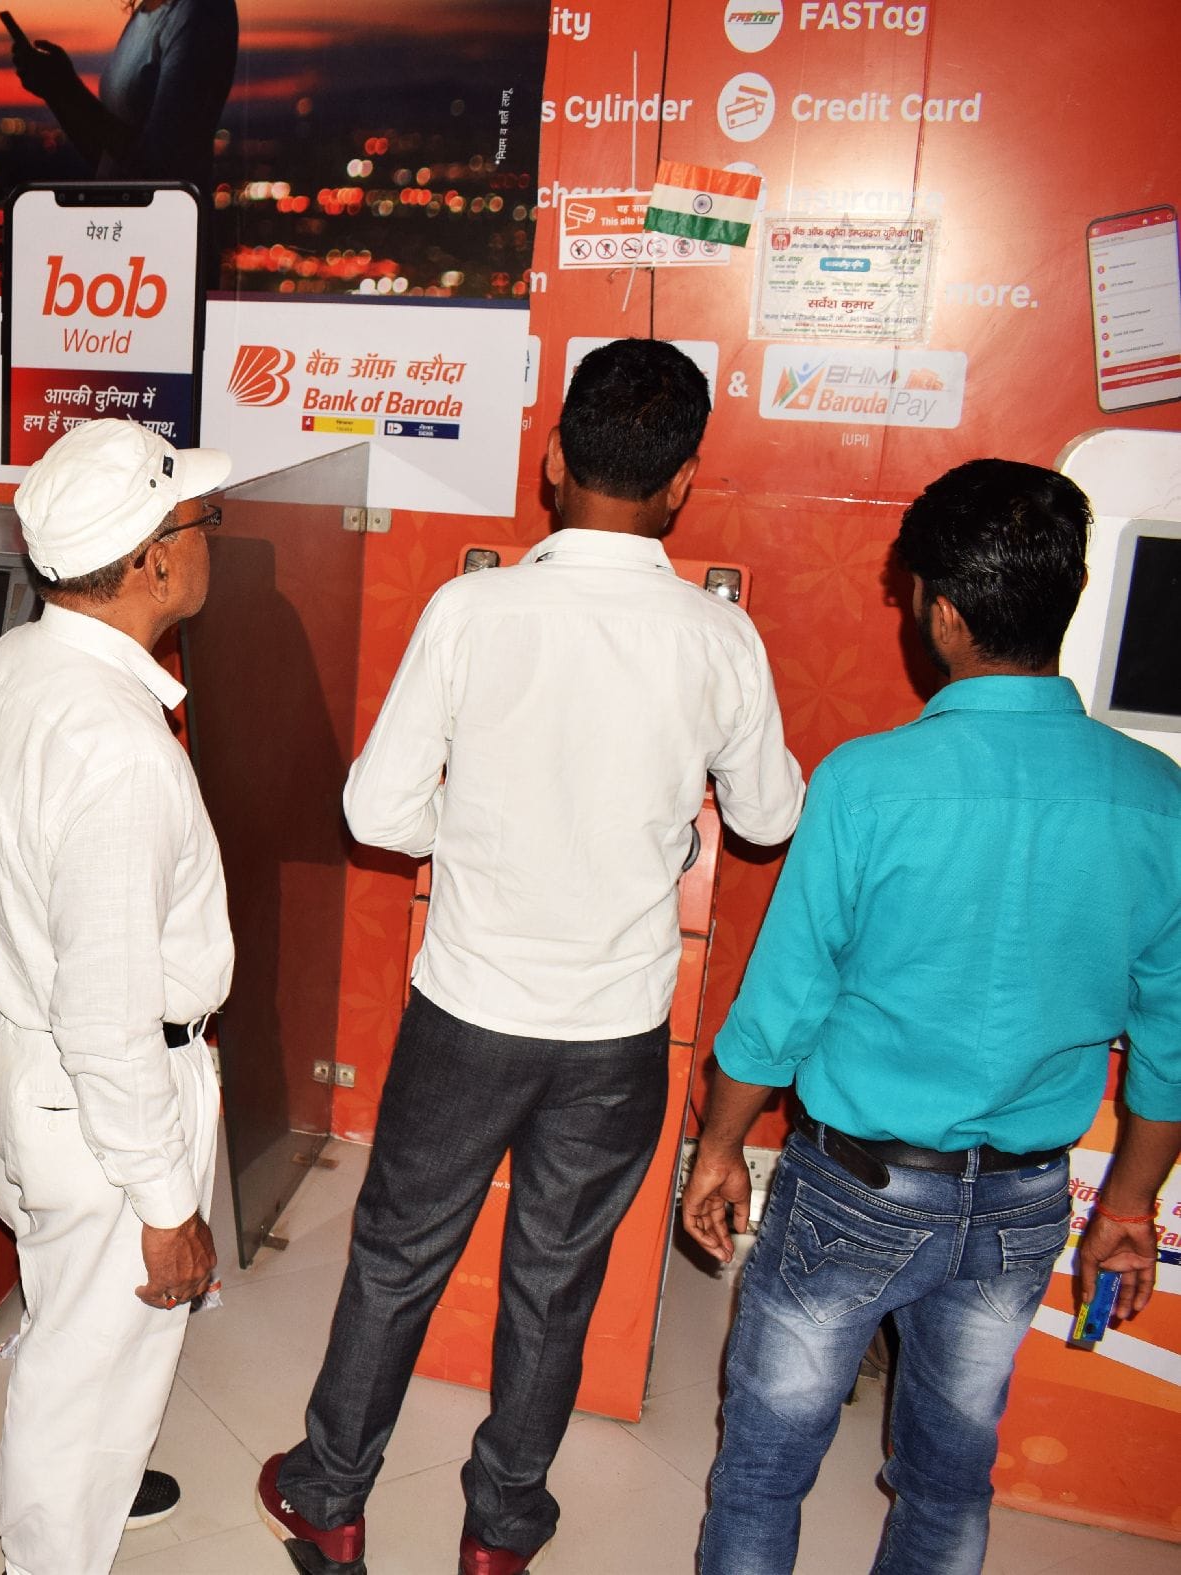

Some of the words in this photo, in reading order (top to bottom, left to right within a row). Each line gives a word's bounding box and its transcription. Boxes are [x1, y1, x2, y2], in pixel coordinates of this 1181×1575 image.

[551, 6, 591, 41] ity
[799, 1, 927, 36] FASTag
[565, 93, 693, 128] Cylinder
[791, 93, 891, 122] Credit
[900, 93, 982, 122] Card
[86, 220, 108, 240] पेश
[112, 220, 123, 242] है
[601, 217, 618, 225] This
[620, 216, 635, 225] site
[42, 256, 167, 318] bob
[946, 284, 1038, 309] more.
[841, 300, 875, 313] कुमार
[64, 328, 132, 354] World
[305, 348, 341, 377] बैंक
[406, 353, 467, 386] बड़ौदा
[44, 385, 93, 406] आपकी
[95, 386, 139, 412] दुनिया
[142, 387, 156, 409] में
[727, 372, 749, 398] &
[303, 388, 359, 413] Bank
[361, 391, 385, 414] of
[385, 391, 463, 417] Baroda
[818, 387, 888, 414] Baroda
[892, 392, 937, 422] Pay
[23, 414, 45, 432] हम
[47, 410, 61, 433] हैं
[842, 432, 869, 448] (UPI)
